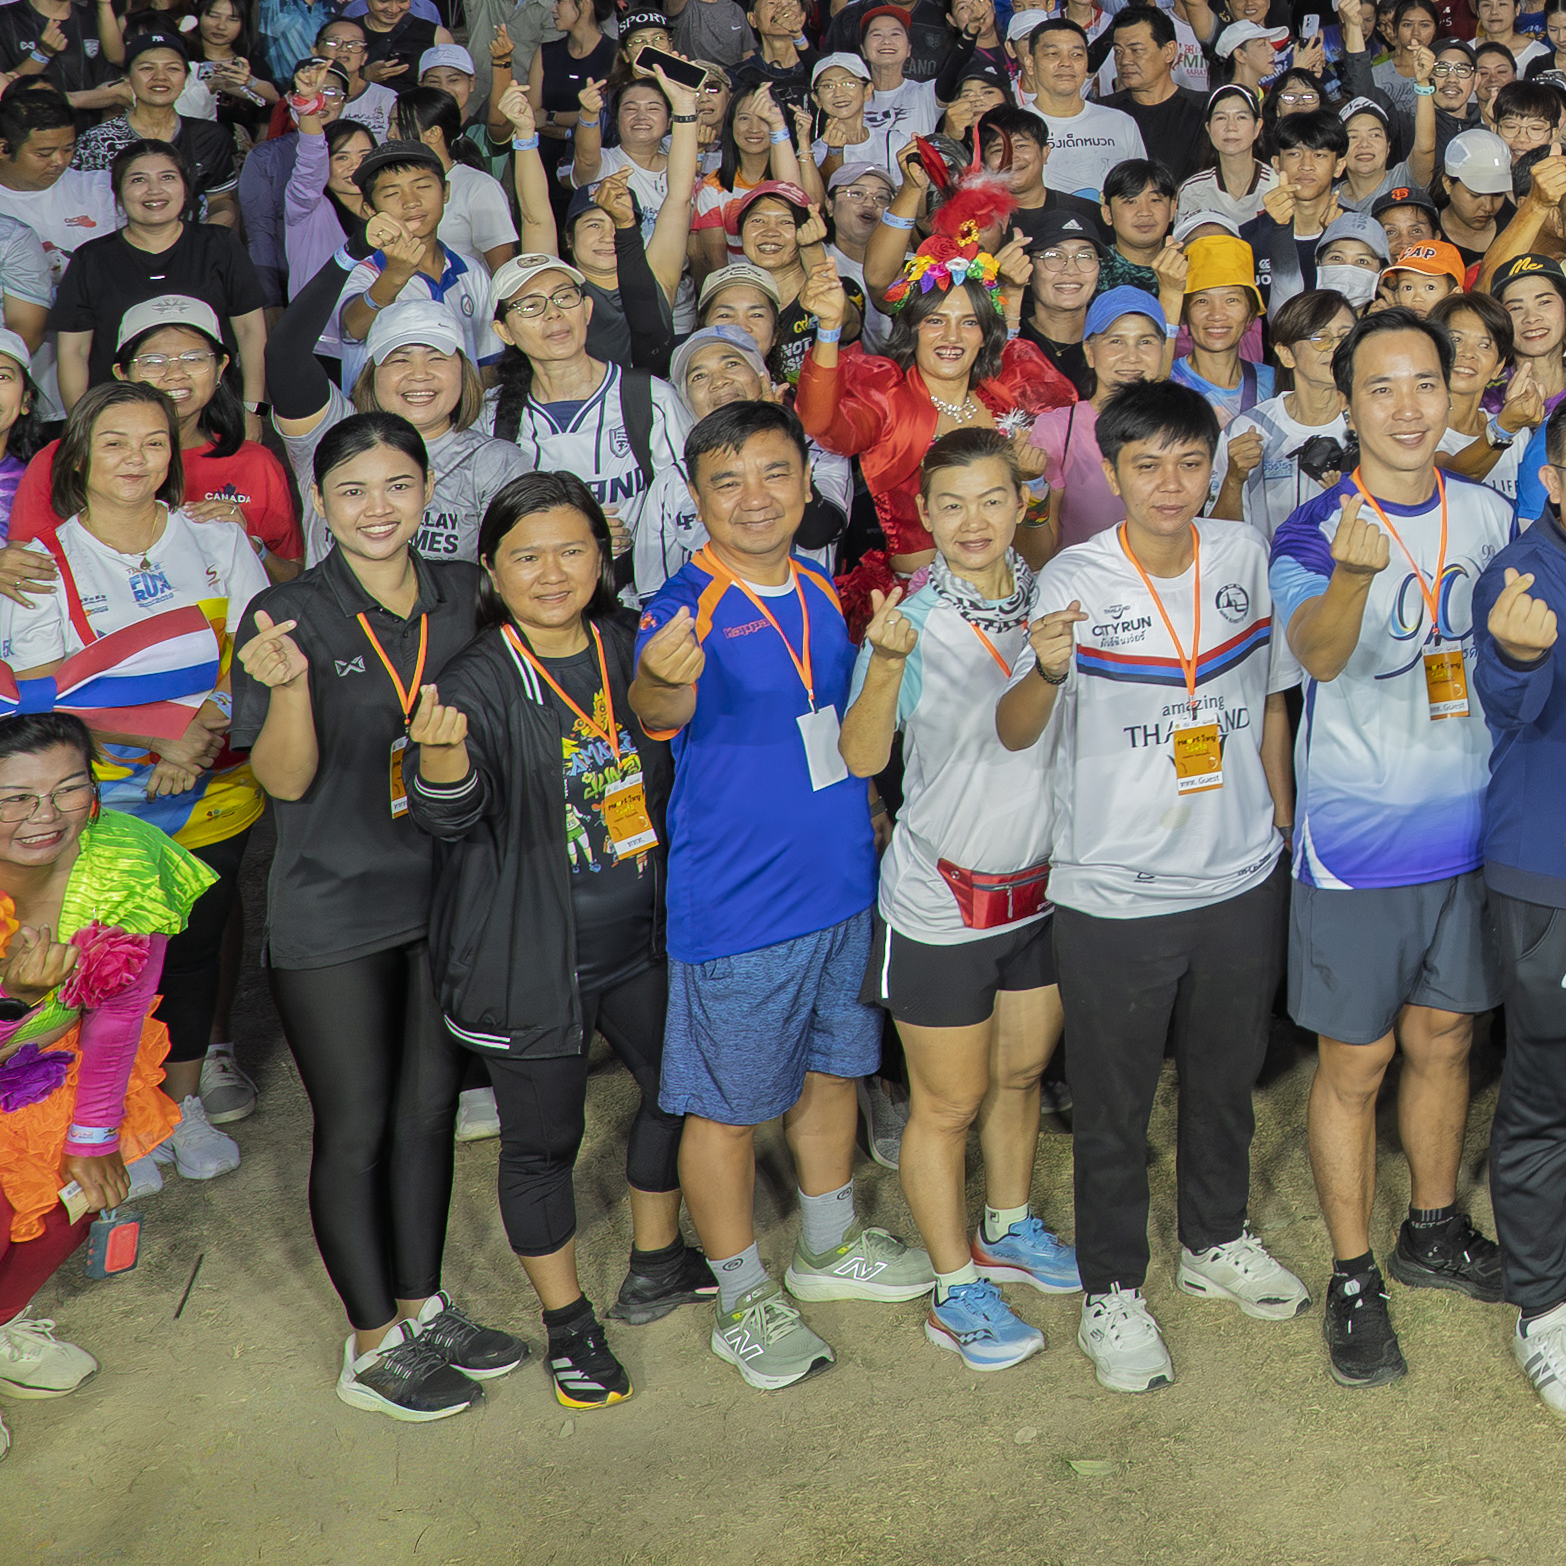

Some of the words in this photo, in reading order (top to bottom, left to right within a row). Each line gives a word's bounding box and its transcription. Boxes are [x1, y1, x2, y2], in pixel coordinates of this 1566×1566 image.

[618, 12, 668, 34] SPORT
[205, 492, 252, 504] CANADA
[724, 619, 771, 640] Kappa
[1091, 622, 1122, 638] CITY
[1123, 615, 1152, 634] RUN
[1162, 695, 1226, 718] amazing
[1123, 708, 1252, 749] THND
[1198, 775, 1220, 785] Guest
